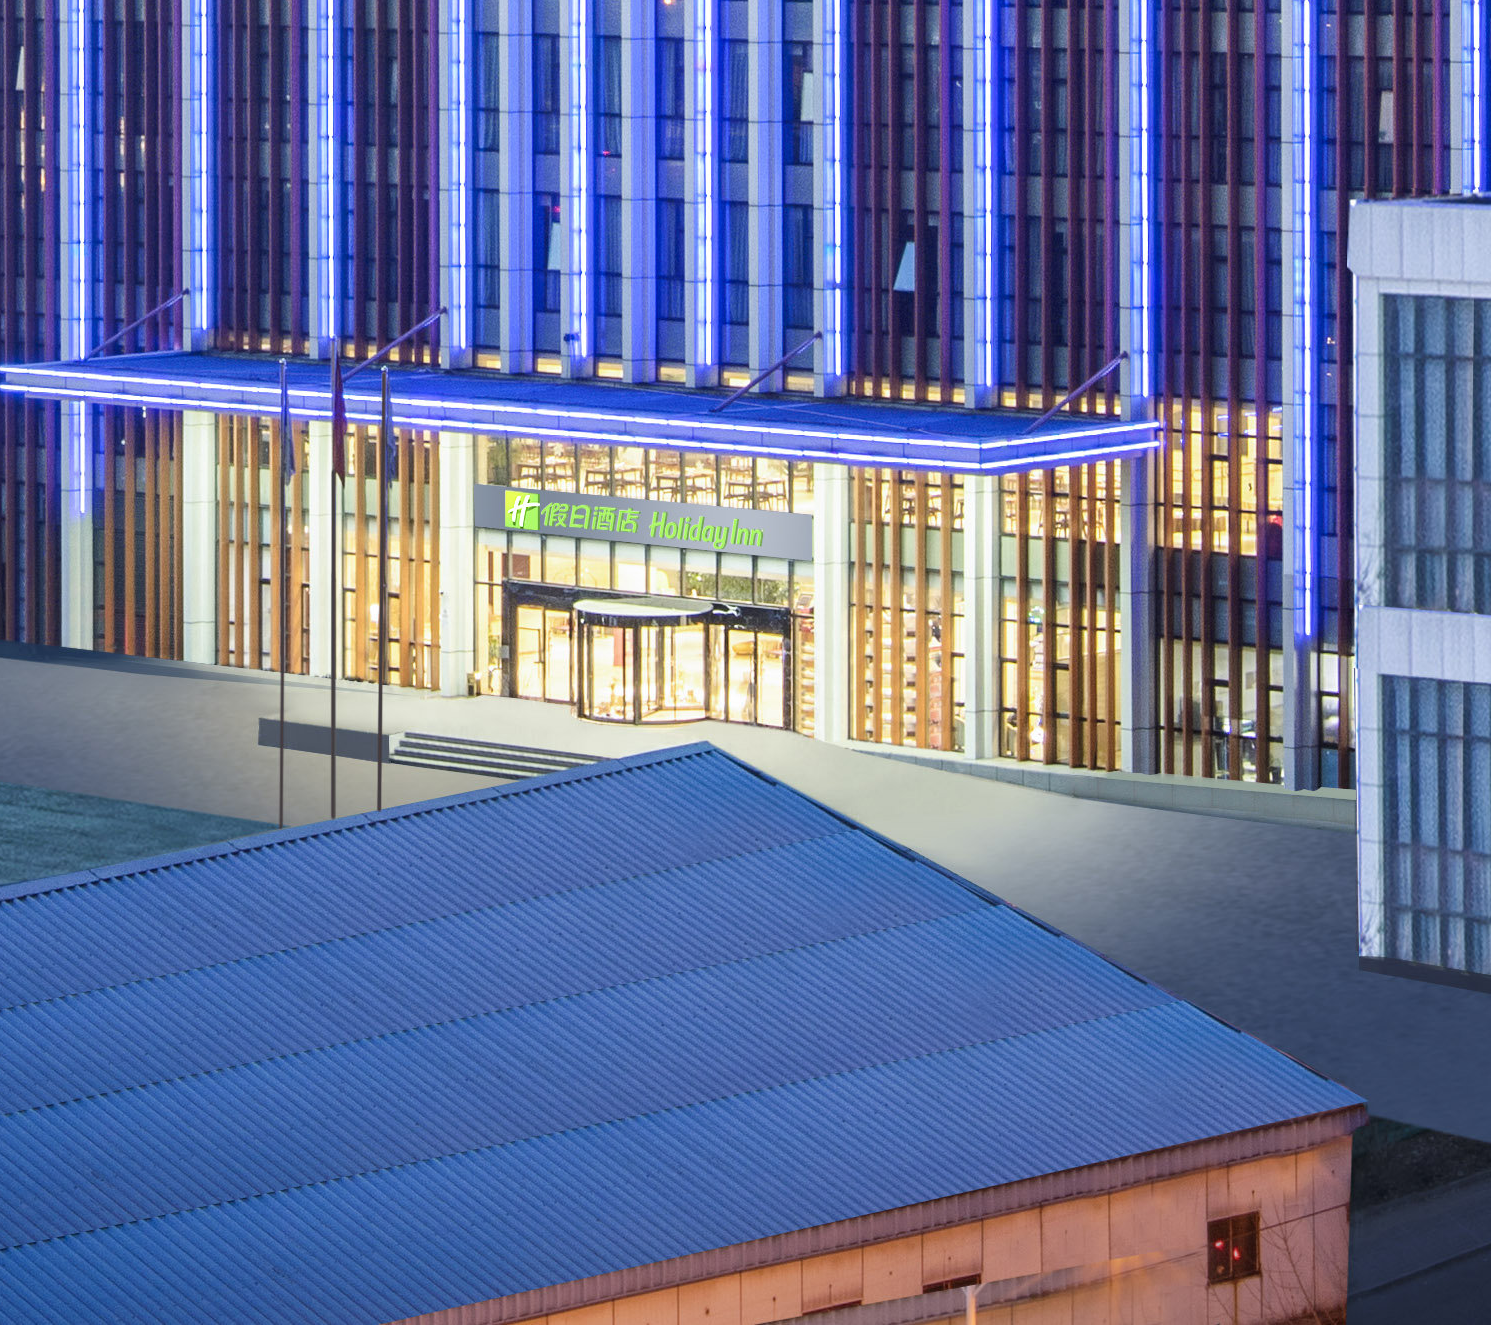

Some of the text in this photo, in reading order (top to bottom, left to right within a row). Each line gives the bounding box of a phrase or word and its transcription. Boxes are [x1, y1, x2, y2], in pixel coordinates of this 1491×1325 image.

[541, 502, 640, 534] 假日酒店
[649, 511, 764, 550] Holiday Inn
